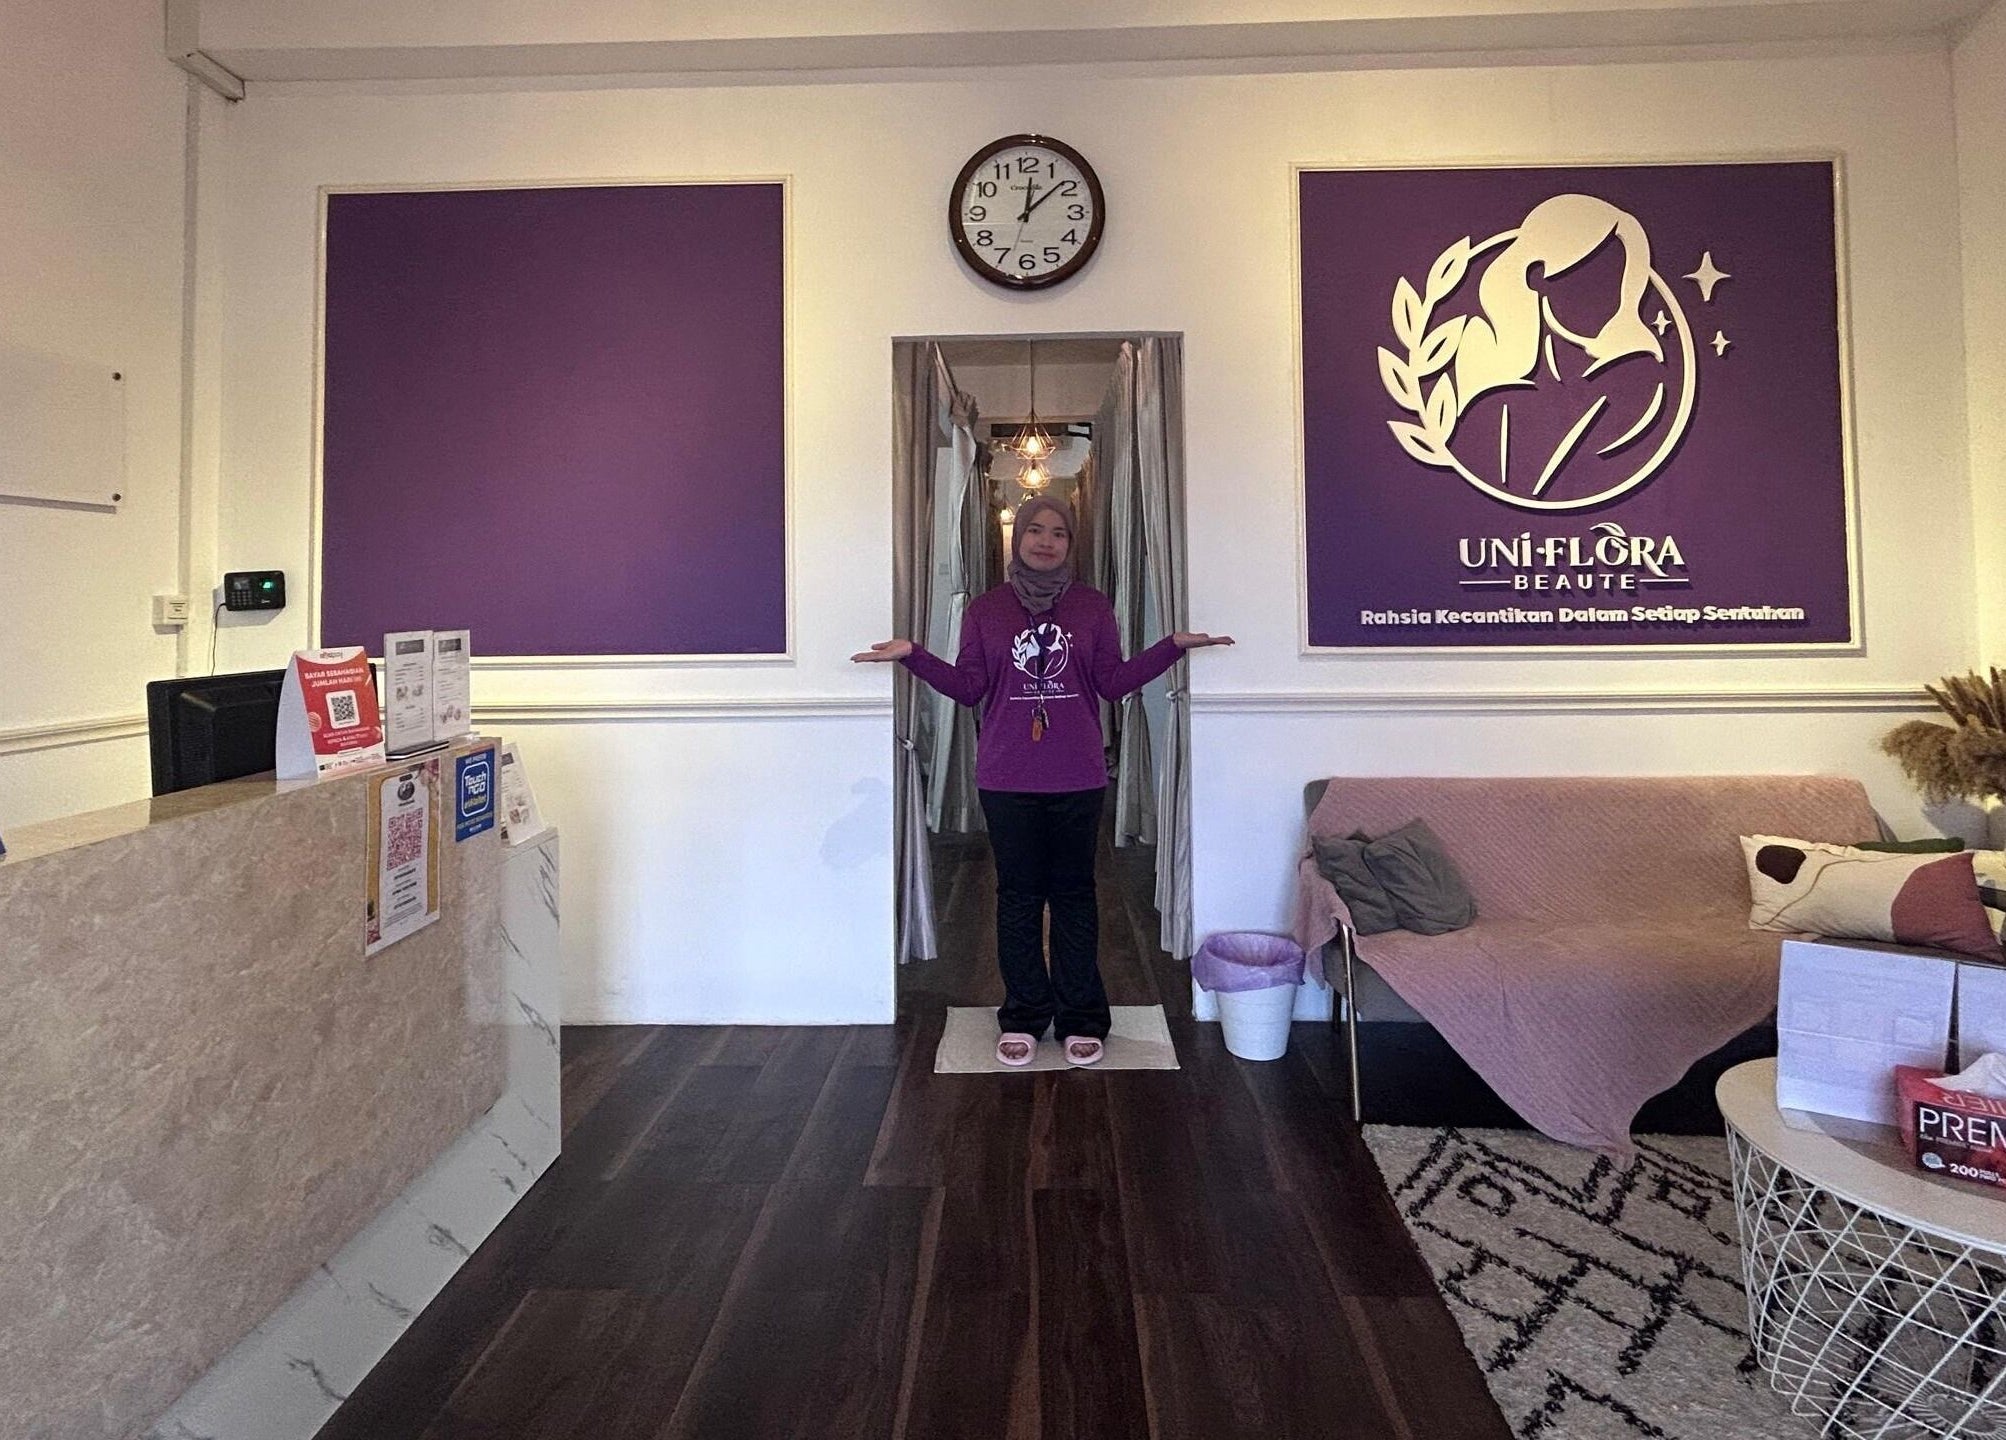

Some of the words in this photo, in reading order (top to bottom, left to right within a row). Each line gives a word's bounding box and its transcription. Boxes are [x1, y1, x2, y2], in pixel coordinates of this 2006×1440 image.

[994, 163, 1010, 180] 11
[1016, 157, 1040, 173] 12
[1047, 162, 1055, 180] 1
[976, 181, 998, 198] 10
[1061, 180, 1078, 197] 2
[969, 205, 987, 222] 9
[1067, 204, 1085, 220] 3
[976, 230, 994, 246] 8
[1060, 229, 1078, 245] 4
[993, 247, 1012, 264] 7
[1018, 253, 1036, 270] 6
[1043, 247, 1061, 263] 5
[1514, 573, 1635, 590] BEAUTE
[1360, 609, 1432, 625] Rahsia
[1434, 607, 1554, 624] Kecantikan
[1558, 607, 1629, 622] Dalam
[1631, 606, 1701, 623] Setiap
[1702, 605, 1805, 621] Sentuhan
[464, 771, 487, 787] Touch
[1949, 1163, 1979, 1178] 200
